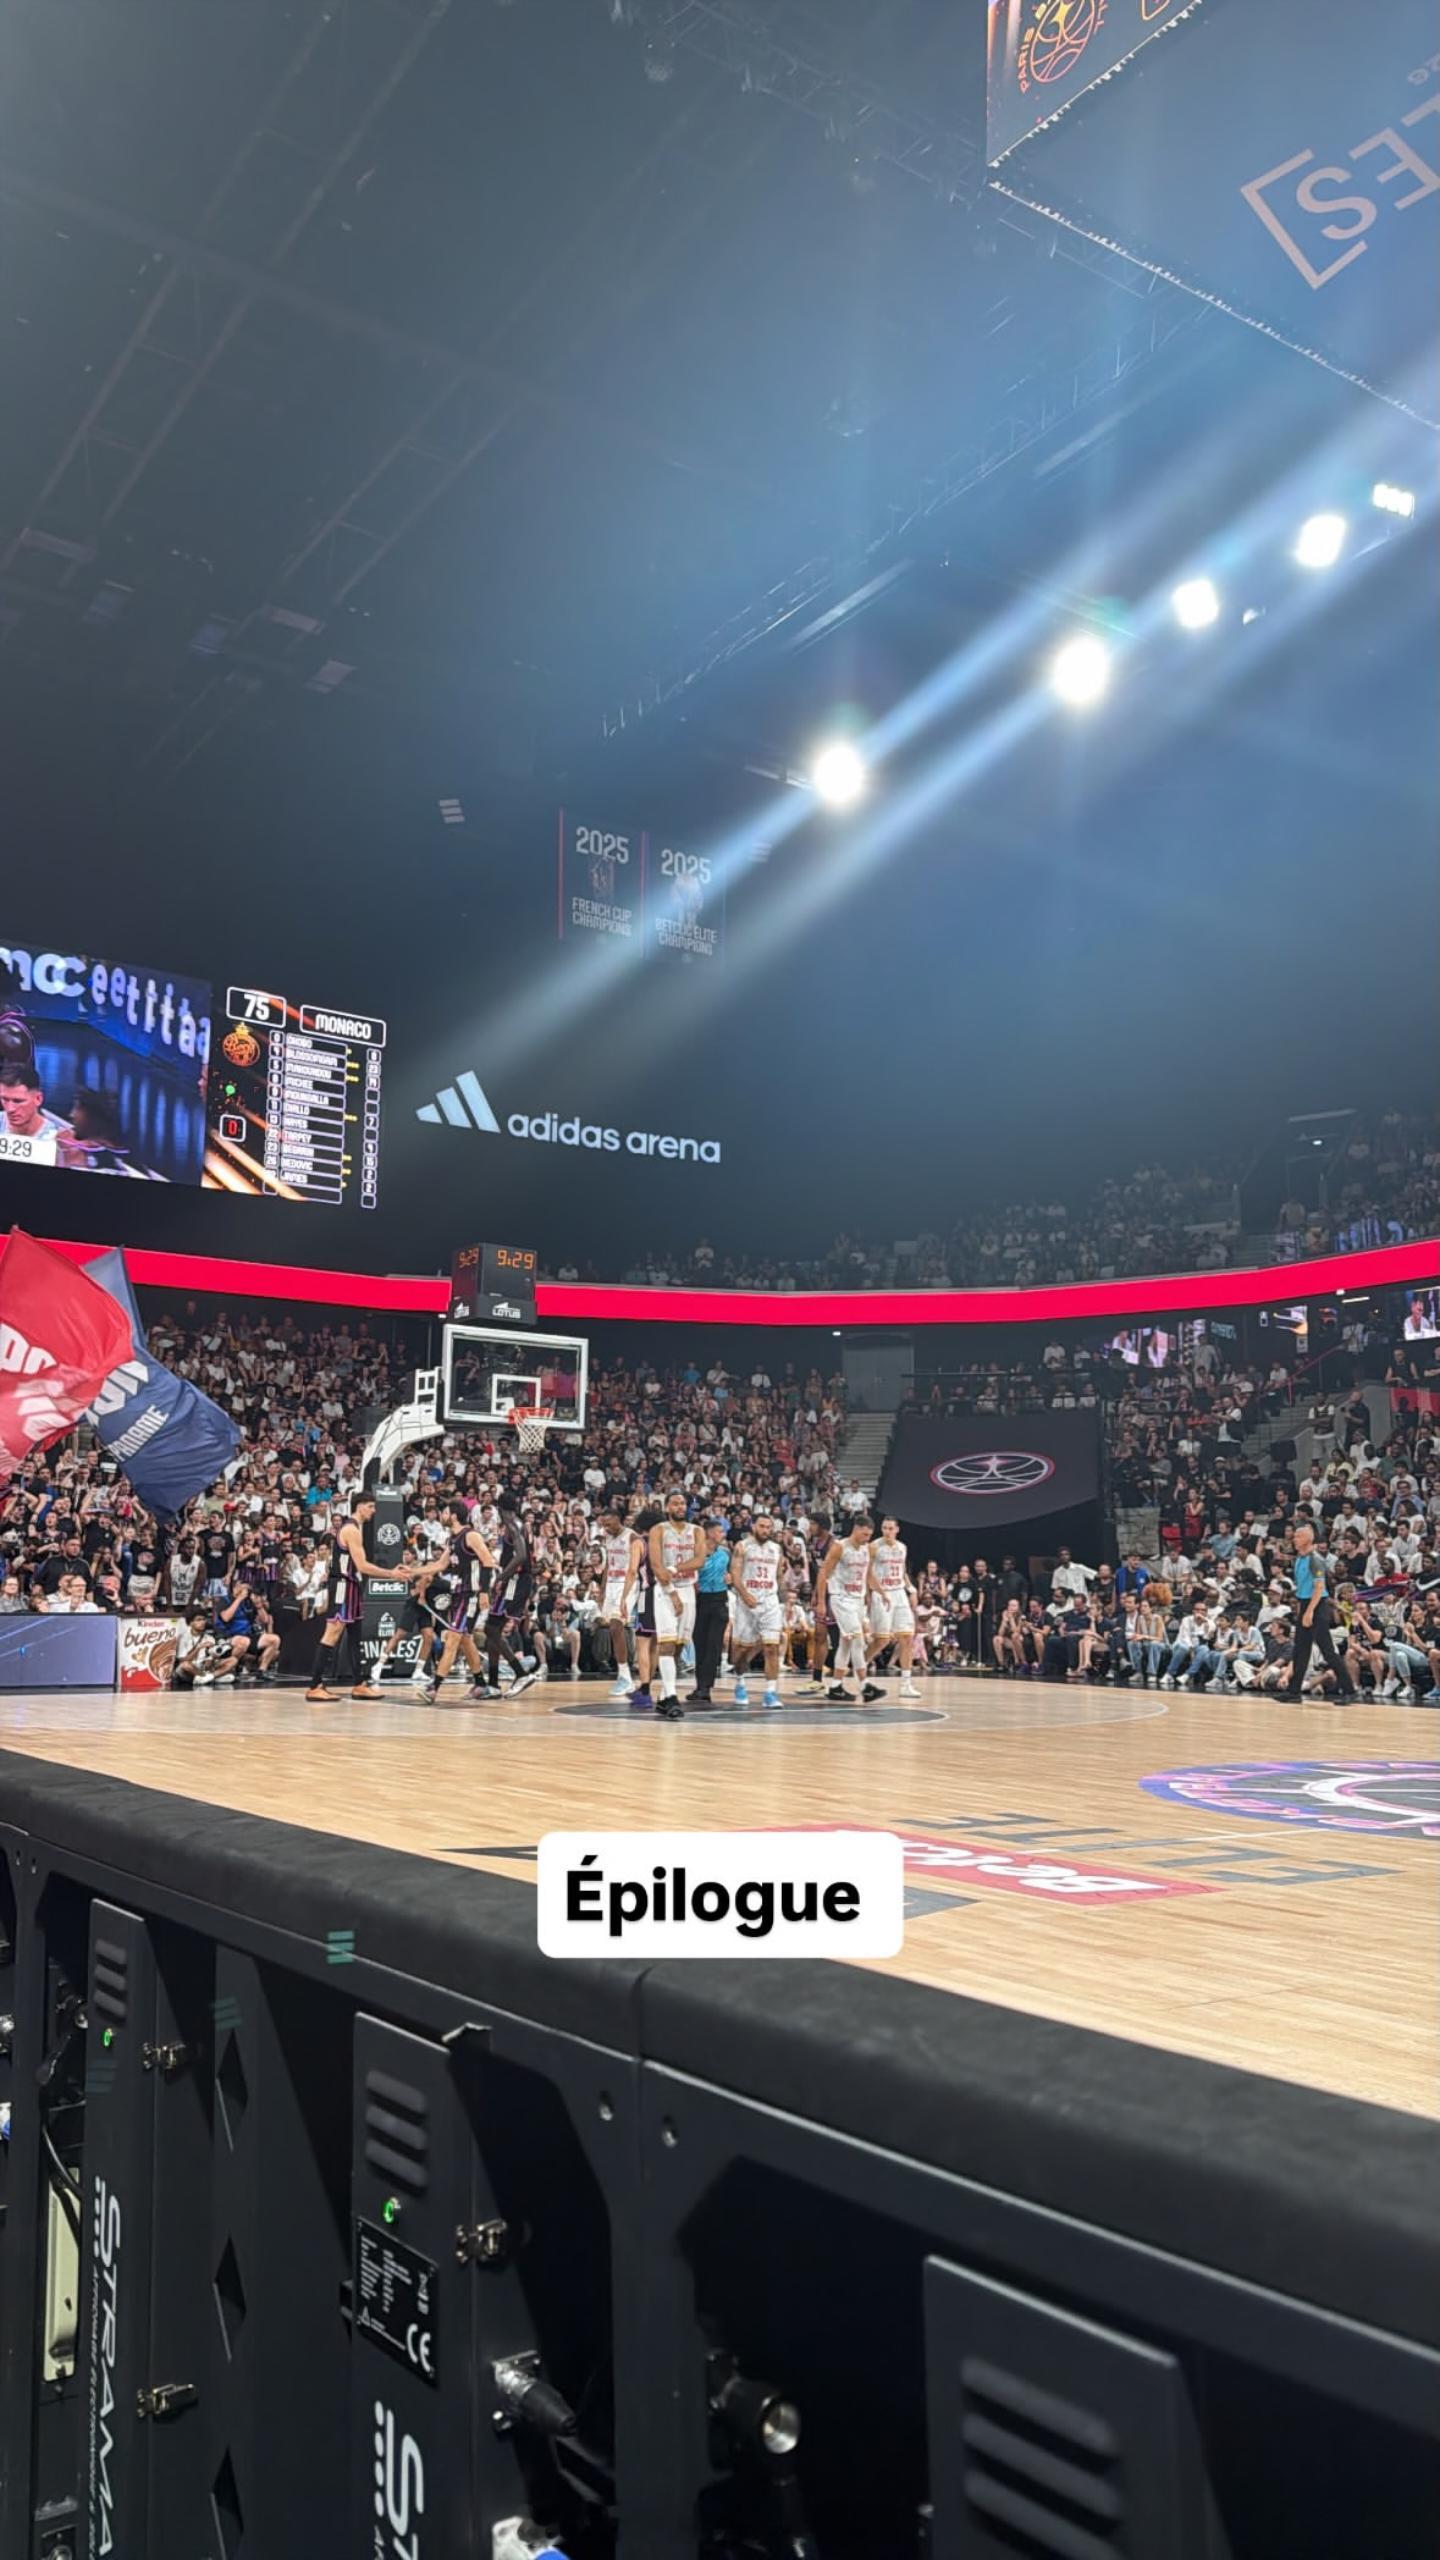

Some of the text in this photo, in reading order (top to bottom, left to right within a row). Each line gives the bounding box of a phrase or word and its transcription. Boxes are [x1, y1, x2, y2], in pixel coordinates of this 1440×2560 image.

[575, 826, 629, 864] 2025
[661, 849, 711, 884] 2025
[572, 896, 633, 923] FRENCH CUP
[572, 911, 632, 937] CHAMPIONS
[693, 926, 720, 944] ELITE
[244, 994, 271, 1021] 75
[315, 1013, 371, 1040] MONACO
[507, 1112, 720, 1163] adidas arena
[756, 1566, 769, 1579] 31
[124, 1627, 177, 1648] bueno
[406, 2322, 433, 2374] CE
